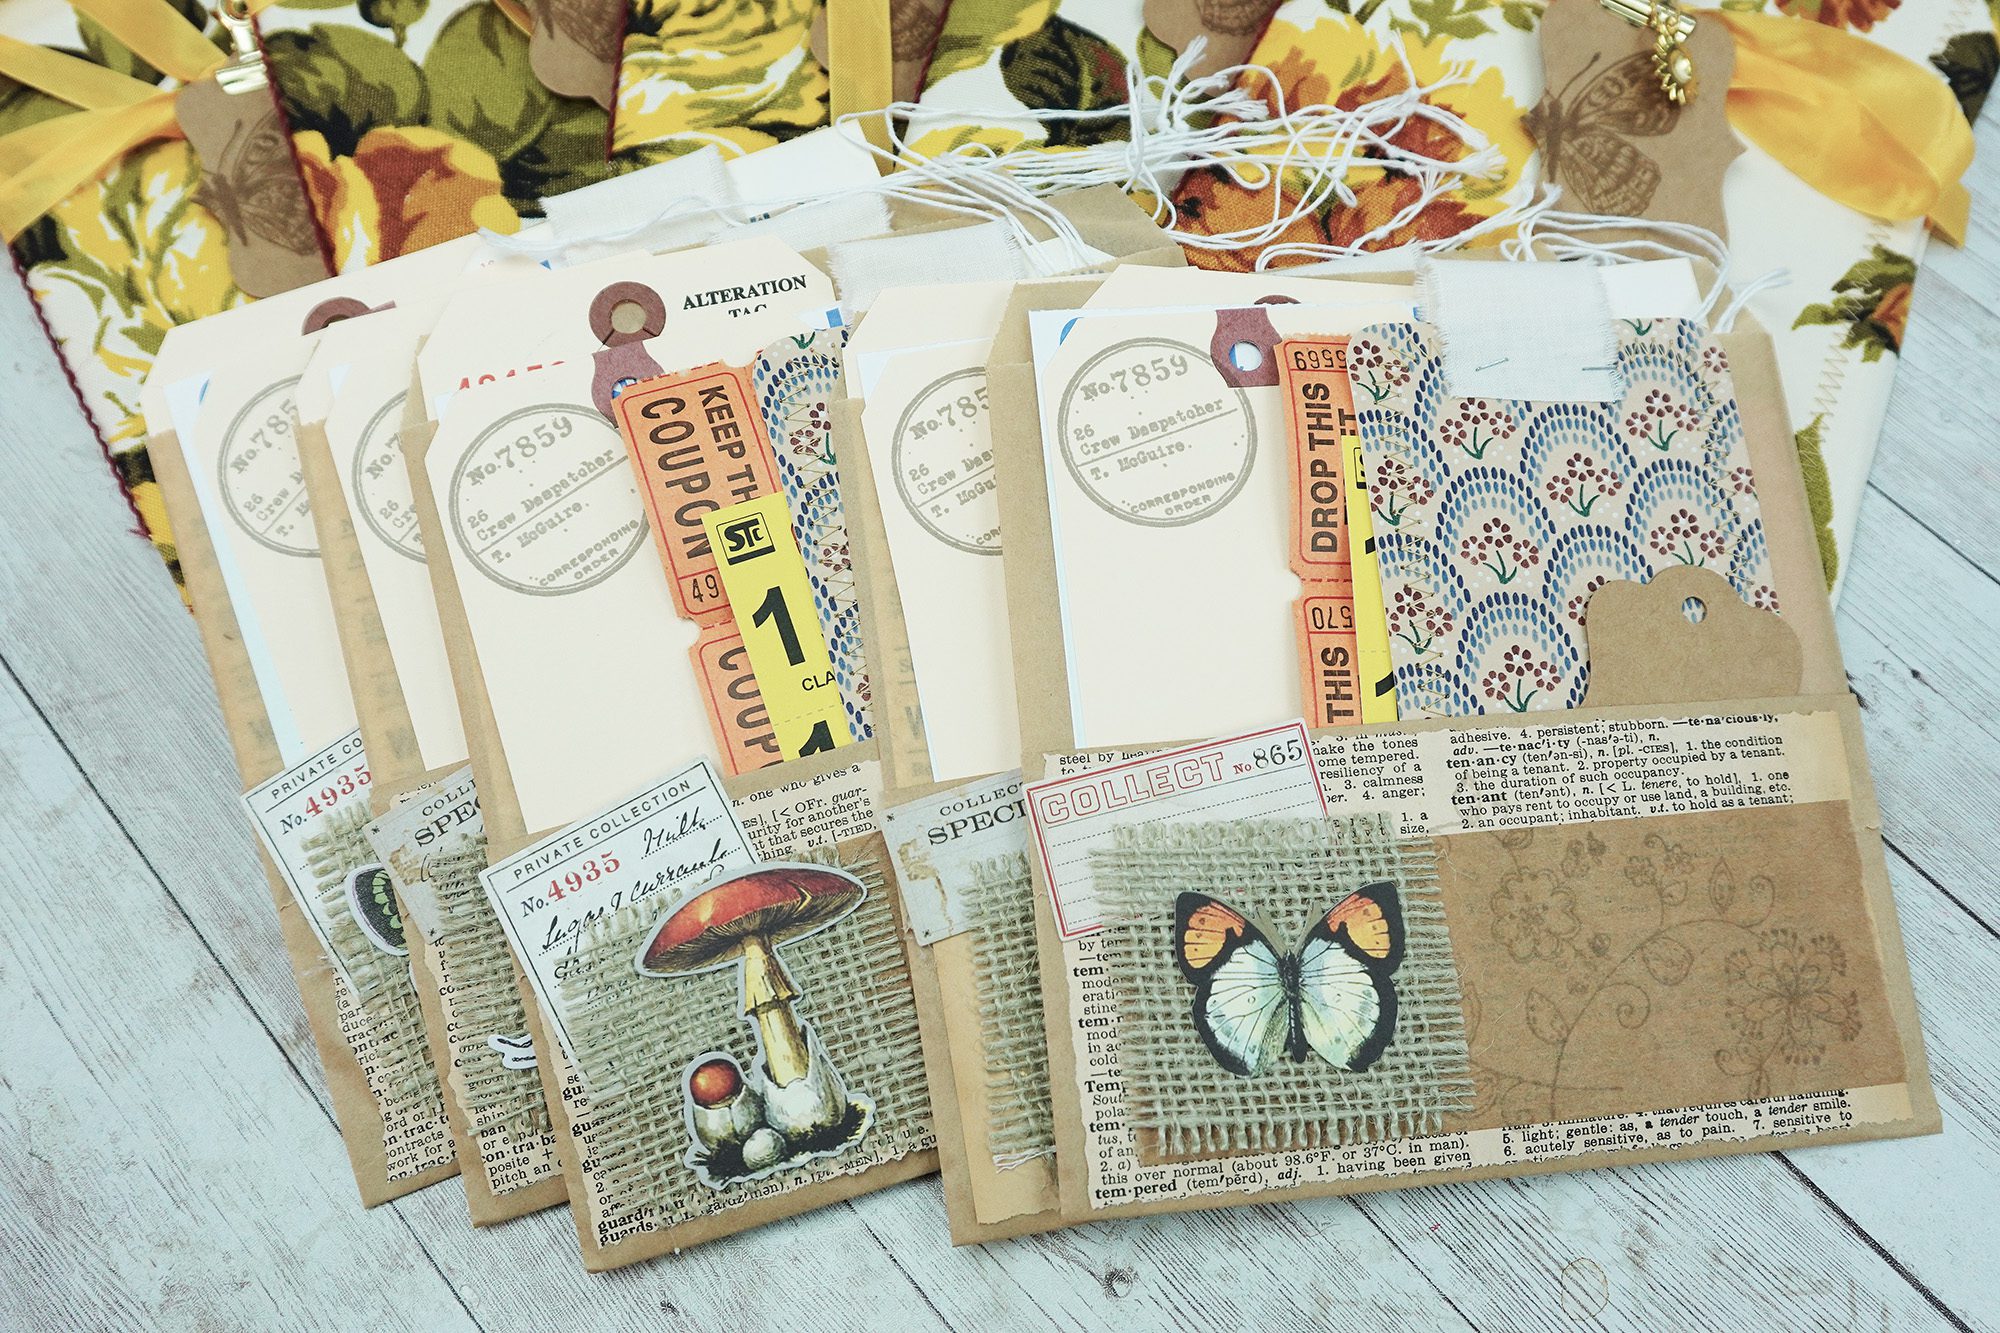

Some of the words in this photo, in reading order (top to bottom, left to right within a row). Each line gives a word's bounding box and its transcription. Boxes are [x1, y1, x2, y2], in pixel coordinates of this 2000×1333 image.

[683, 275, 807, 310] ALTERATION
[698, 385, 746, 459] KEEP
[1302, 383, 1334, 450] THIS
[1074, 424, 1095, 441] 26
[1080, 434, 1121, 455] Crew
[641, 397, 720, 559] COUPON
[909, 463, 929, 481] 26
[917, 470, 956, 495] Crew
[1090, 467, 1109, 481] T.
[244, 493, 263, 513] 26
[256, 488, 289, 522] Crew
[1131, 472, 1235, 514] CORRESPONDING
[1165, 494, 1211, 515] ORDER
[1311, 459, 1338, 552] DROP
[380, 499, 399, 520] 26
[468, 510, 489, 529] 26
[931, 504, 949, 518] T.
[276, 524, 294, 537] T.
[476, 512, 516, 541] Crew
[976, 525, 1001, 546] COR
[491, 550, 511, 564] T.
[539, 519, 639, 586] CORRESPONDING
[574, 548, 619, 580] ORDER
[752, 586, 805, 666] 1
[1321, 647, 1354, 723] THIS
[1451, 732, 1510, 744] adhesive.
[1537, 725, 1605, 739] persistent;
[1609, 721, 1668, 732] stubborn.
[1701, 739, 1721, 749] the
[1725, 735, 1783, 748] condition
[1351, 750, 1419, 764] tempered.
[1353, 742, 1374, 752] the
[1382, 739, 1418, 749] tones
[1060, 754, 1090, 766] steel
[1098, 751, 1114, 762] by
[1320, 766, 1384, 780] resiliency
[1394, 762, 1406, 773] of
[1455, 770, 1468, 780] of
[1472, 768, 1507, 779] being
[1523, 763, 1569, 774] tenant.
[1593, 757, 1648, 771] property
[1652, 752, 1706, 765] occupied
[1712, 750, 1725, 761] by
[1741, 747, 1785, 758] tenant.
[271, 754, 337, 799] PRIVATE
[750, 790, 773, 802] one
[852, 765, 861, 773] a
[1040, 752, 1224, 824] COLLECT
[1253, 739, 1302, 769] 865
[1364, 776, 1423, 788] calmness
[1474, 781, 1495, 791] the
[1501, 776, 1557, 789] duration
[1562, 773, 1575, 783] of
[1580, 771, 1608, 782] such
[1614, 767, 1684, 780] occupancy.
[1641, 779, 1681, 790] tenere,
[1768, 771, 1789, 780] one
[305, 764, 371, 817] 4935
[795, 798, 827, 813] OFr.
[832, 788, 867, 805] guar-
[1383, 788, 1425, 798] anger;
[1460, 804, 1487, 816] who
[1492, 802, 1522, 818] pays
[1526, 800, 1553, 812] rent
[1556, 799, 1570, 808] to
[1575, 794, 1619, 808] occupy
[1624, 795, 1637, 803] or
[1641, 793, 1661, 802] use
[1665, 789, 1697, 800] land,
[1712, 784, 1766, 796] building,
[1769, 783, 1791, 792] etc.
[748, 823, 780, 840] urity
[786, 817, 804, 829] for
[809, 797, 870, 823] another's
[1478, 818, 1494, 827] an
[1499, 810, 1564, 826] occupant;
[1568, 805, 1641, 820] inhabitant.
[1650, 804, 1669, 814] v.t.
[1690, 797, 1717, 810] hold
[1749, 794, 1794, 805] tenant;
[515, 837, 583, 880] PRIVATE
[589, 780, 690, 839] COLLECTION
[770, 831, 797, 843] that
[801, 818, 848, 837] secures
[852, 810, 873, 821] the
[1401, 824, 1429, 834] size,
[807, 835, 828, 848] v.t.
[547, 850, 620, 902] 4935
[1079, 941, 1095, 952] by
[1090, 1054, 1118, 1066] cold
[1522, 1129, 1559, 1143] light;
[1620, 1122, 1638, 1132] as,
[1659, 1115, 1699, 1128] tender
[1705, 1107, 1748, 1123] touch,
[1768, 1102, 1808, 1116] tender
[1813, 1098, 1851, 1112] smile.
[1525, 1140, 1575, 1155] acutely
[1584, 1134, 1648, 1148] sensitive,
[1702, 1124, 1735, 1137] pain.
[1773, 1113, 1831, 1128] sensitive
[425, 1144, 442, 1157] for
[448, 1140, 455, 1148] a
[489, 1156, 529, 1177] posite
[1102, 1174, 1128, 1185] this
[1135, 1170, 1166, 1182] over
[1174, 1162, 1224, 1178] normal
[1232, 1156, 1279, 1173] (about
[1342, 1150, 1356, 1160] or
[1409, 1142, 1422, 1153] in
[1430, 1138, 1469, 1152] man).
[1277, 1168, 1302, 1182] adj.
[1337, 1160, 1386, 1174] having
[1394, 1156, 1425, 1168] been
[1434, 1152, 1470, 1166] given
[492, 1170, 527, 1189] pitch
[534, 1163, 551, 1175] an
